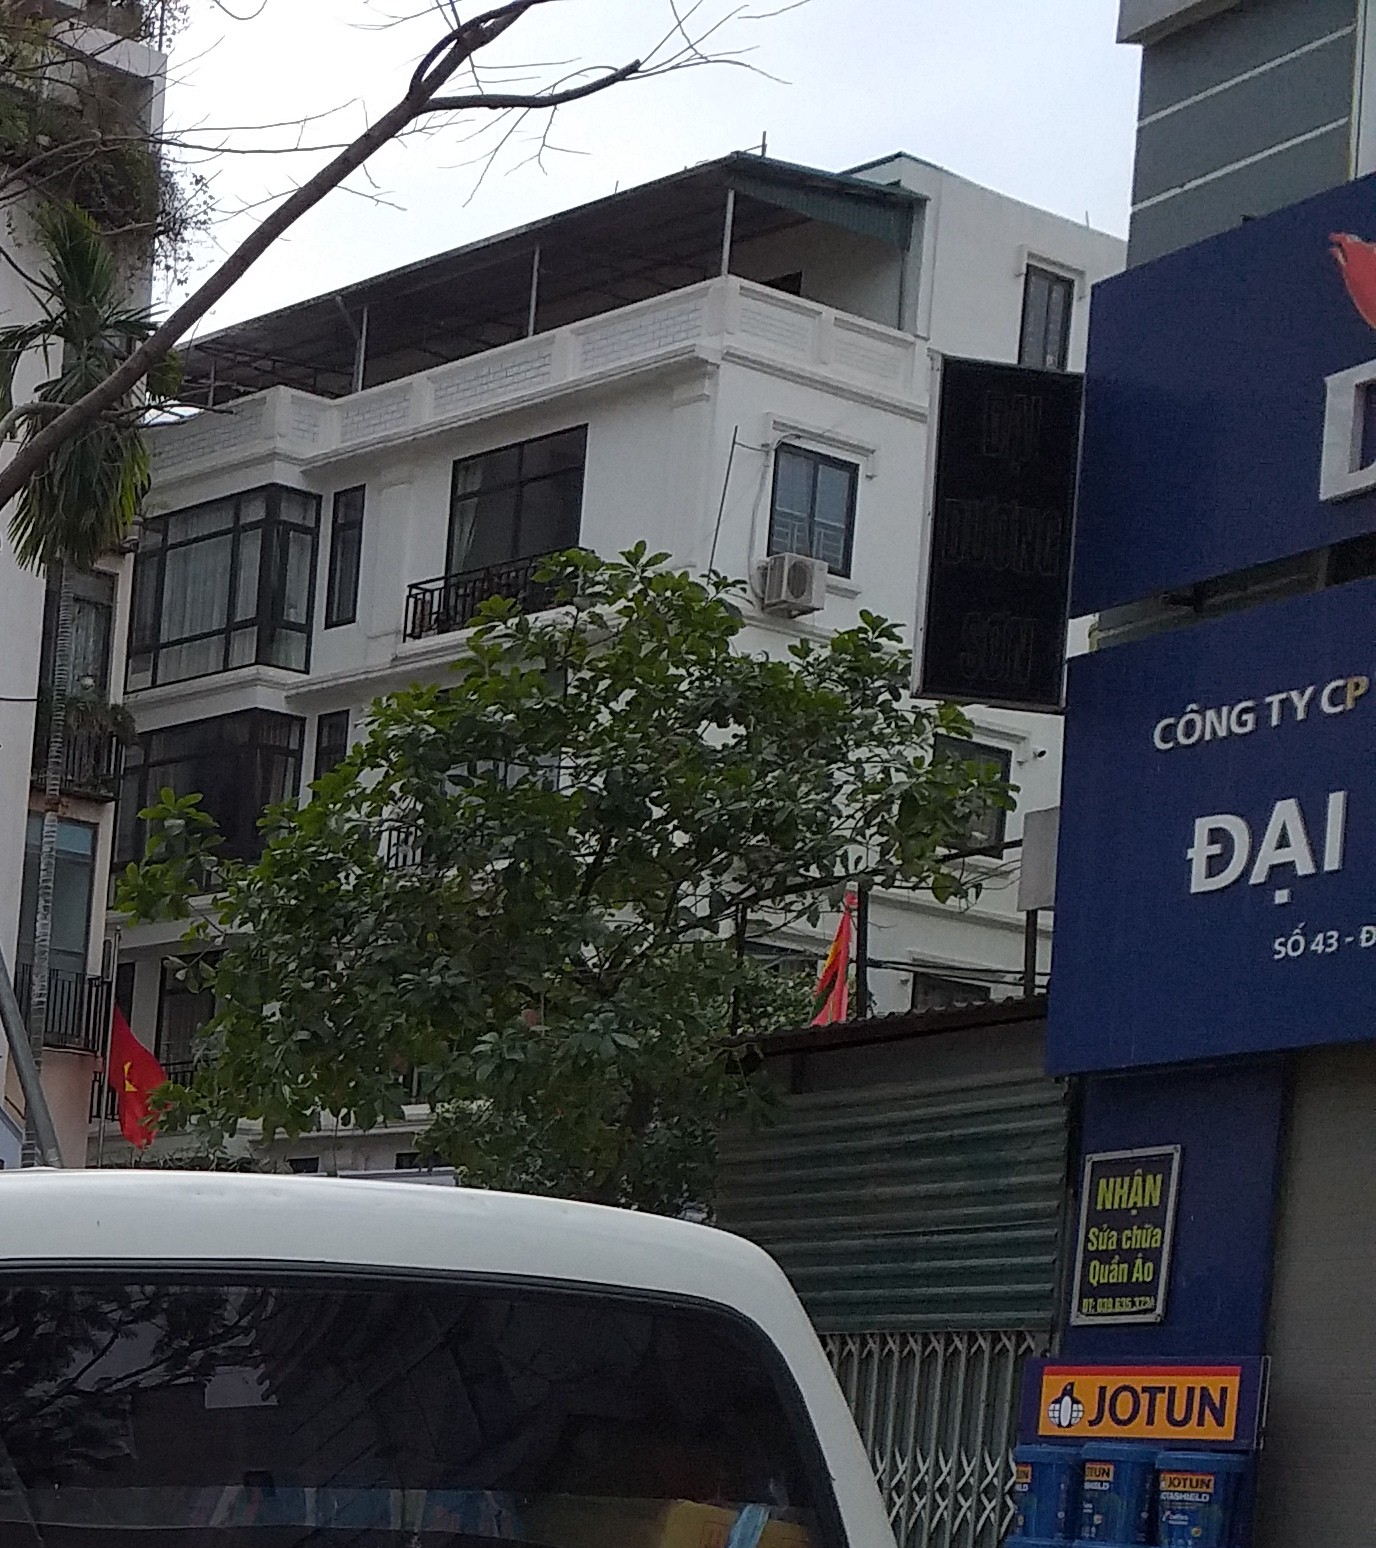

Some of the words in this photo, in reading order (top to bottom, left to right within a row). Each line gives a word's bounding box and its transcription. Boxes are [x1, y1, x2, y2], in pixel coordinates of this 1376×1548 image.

[1152, 703, 1256, 751] CÔNG
[1265, 686, 1316, 728] TY
[1320, 675, 1370, 715] CP
[1186, 790, 1349, 905] ĐẠI
[1273, 922, 1306, 961] SỐ
[1310, 930, 1339, 954] 43
[1096, 1168, 1163, 1216] NHẬN
[1088, 1223, 1118, 1251] Sửa
[1121, 1224, 1162, 1250] chữa
[1088, 1254, 1128, 1287] Quần
[1131, 1252, 1154, 1283] Áo
[1088, 1384, 1228, 1427] JOTUN
[1167, 1476, 1212, 1490] JOTUN
